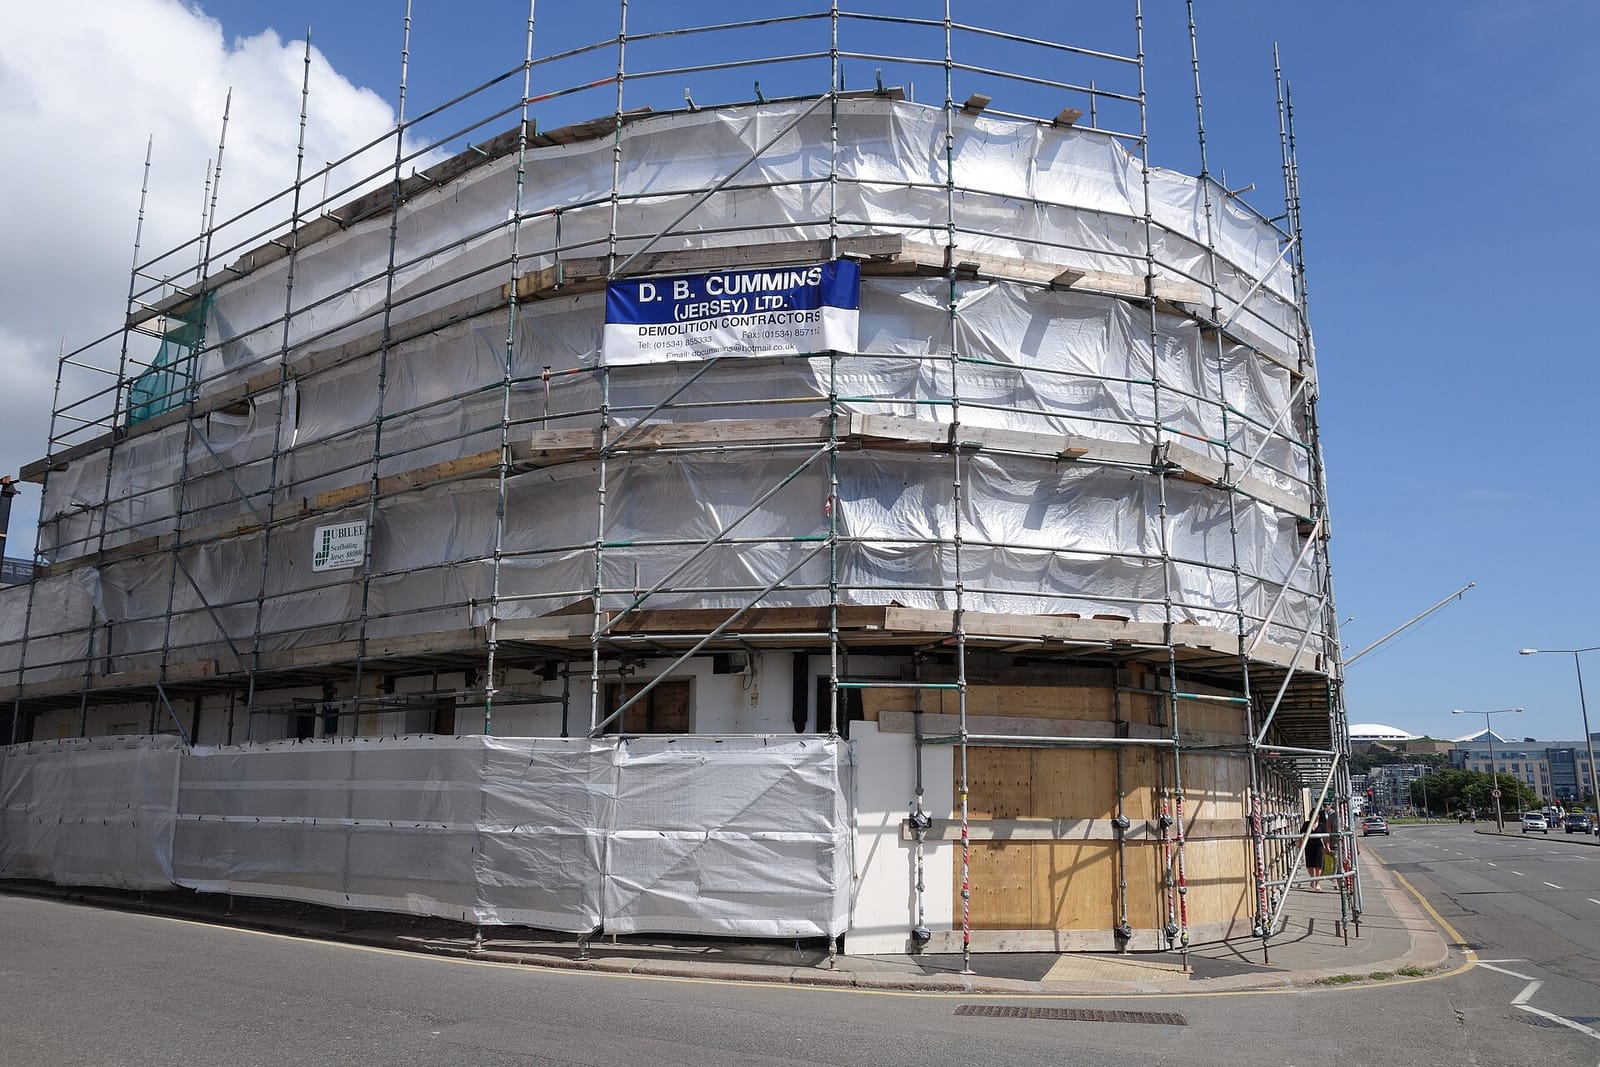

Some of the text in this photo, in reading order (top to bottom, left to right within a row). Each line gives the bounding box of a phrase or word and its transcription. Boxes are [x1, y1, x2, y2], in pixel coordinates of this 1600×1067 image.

[639, 267, 823, 302] D. B. CUMMINS
[674, 295, 788, 321] (JERSEY) LTD.
[638, 310, 821, 337] DEMOLITION CONTRACTORS
[638, 336, 713, 350] Tel: (01534) 855333
[742, 330, 760, 340] Fax:
[761, 329, 793, 340] (01534)
[665, 350, 691, 360] Email:
